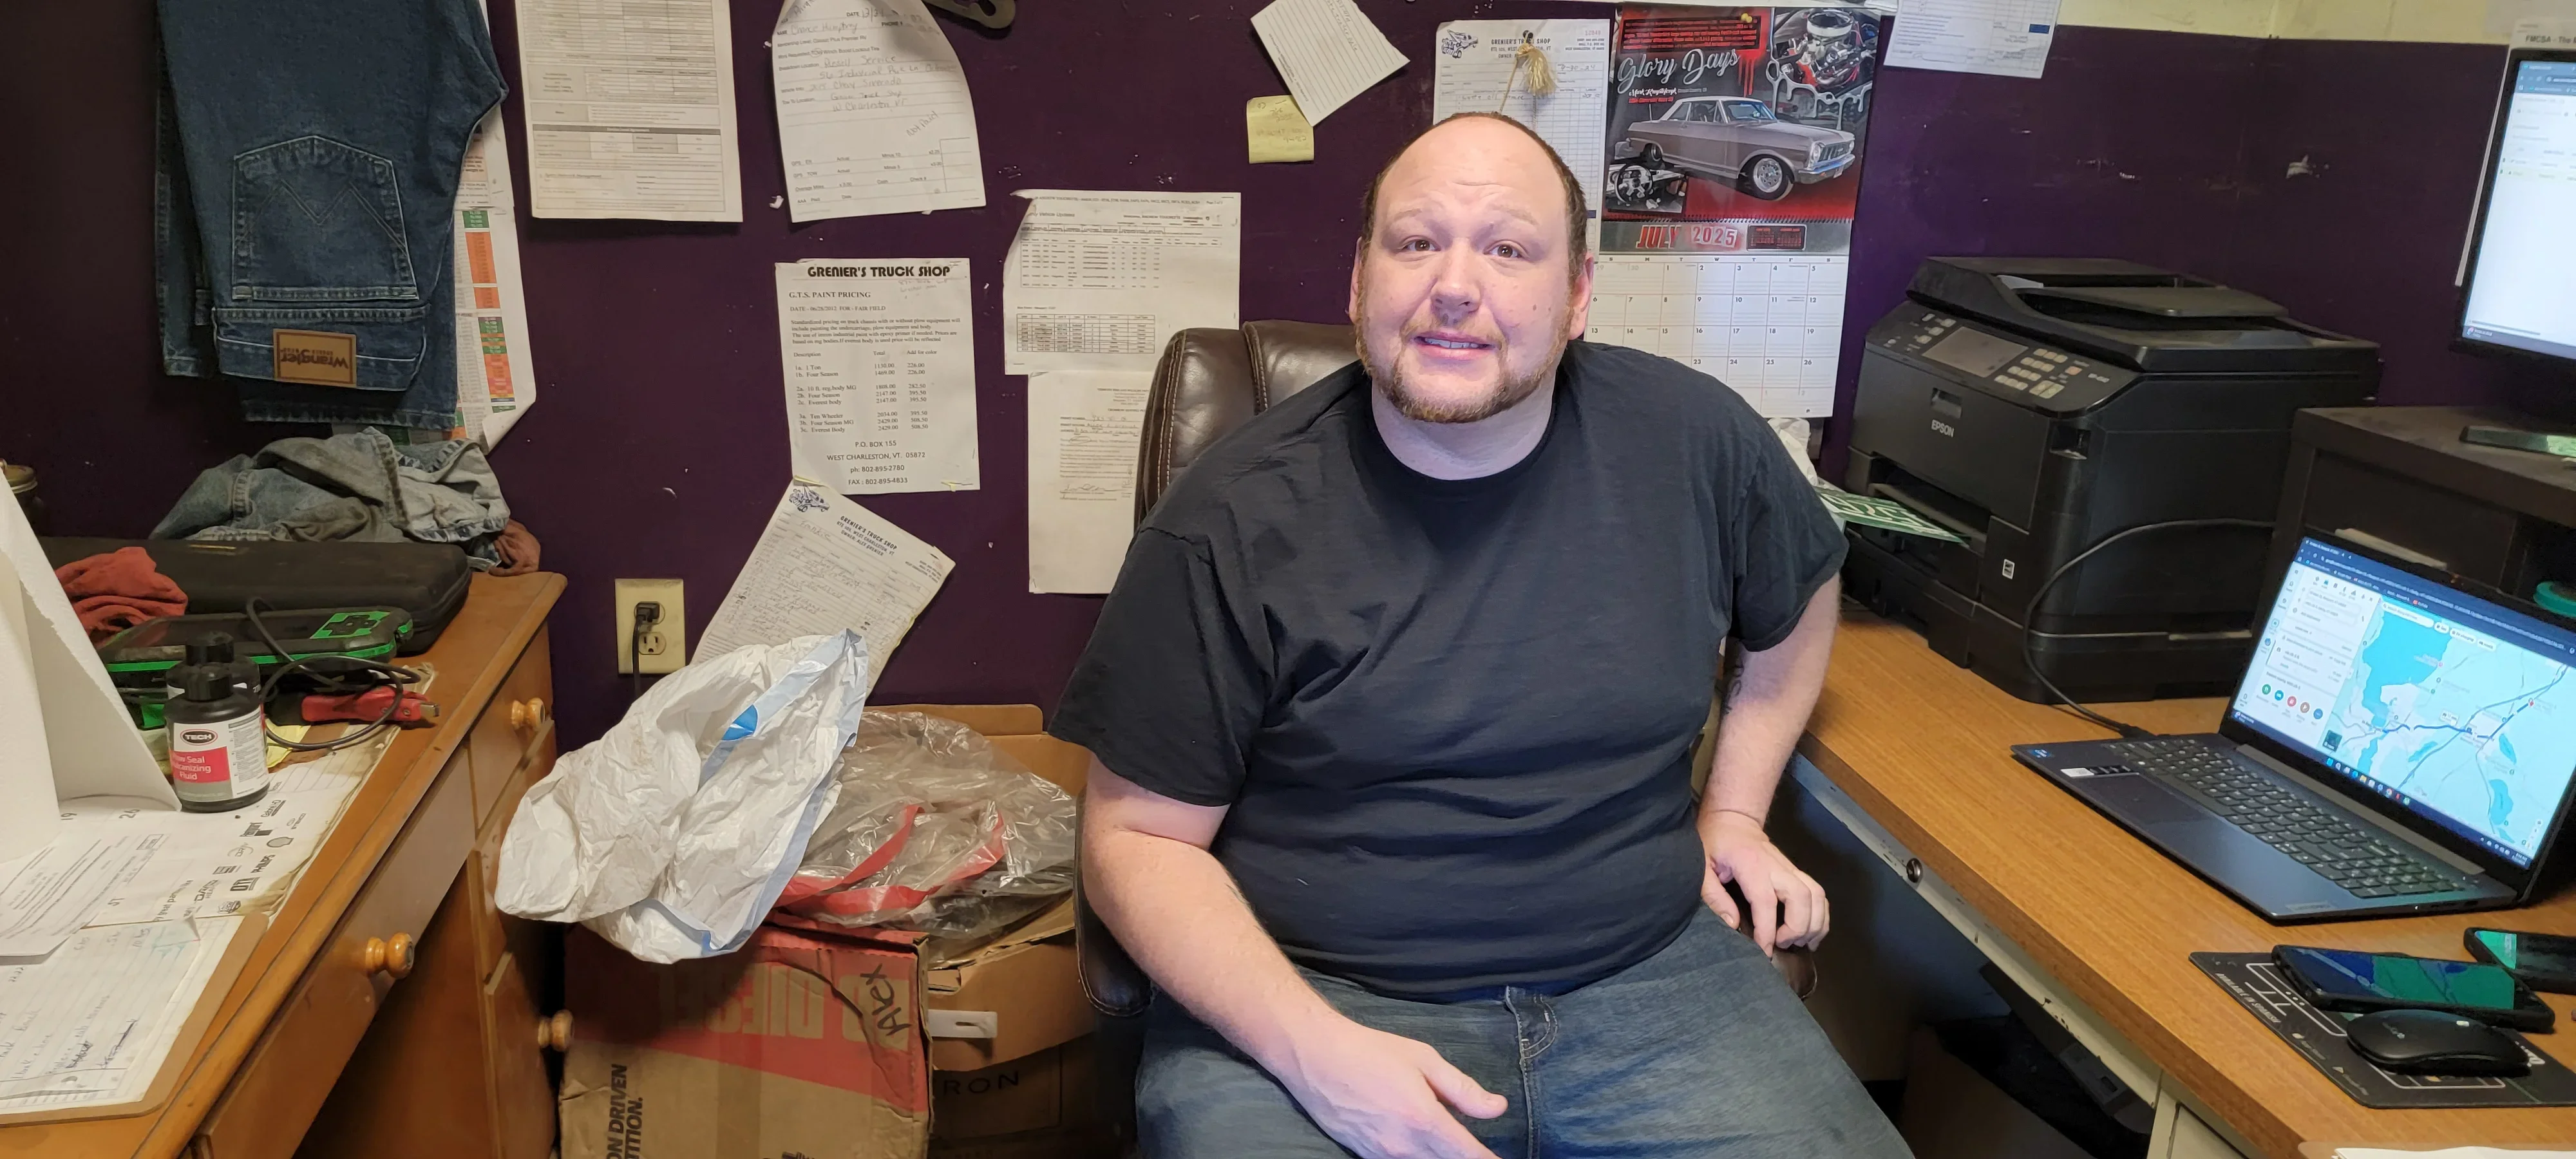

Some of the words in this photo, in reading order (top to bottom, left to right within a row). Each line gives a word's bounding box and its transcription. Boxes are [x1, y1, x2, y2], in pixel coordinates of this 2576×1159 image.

[1617, 54, 1676, 94] Glory
[1681, 48, 1741, 85] Days
[1636, 225, 1681, 249] JULY
[1692, 226, 1738, 248] 2025
[808, 267, 866, 278] GRENIER'S
[870, 267, 914, 277] TRUCK
[918, 266, 951, 277] SHOP
[281, 349, 349, 370] Wrangler
[1931, 419, 1955, 438] EPSON
[840, 516, 867, 533] GRENIER'S
[867, 530, 884, 543] TRUCK
[883, 540, 898, 550] SHOP
[840, 530, 856, 541] OWNER:
[866, 544, 884, 556] GRENIER
[853, 530, 864, 538] WEST
[864, 536, 889, 553] CHARLESTON,
[180, 771, 198, 780] Fluid
[118, 809, 140, 819] 26
[860, 963, 911, 1036] Alex
[608, 1063, 627, 1134] DRIVEN
